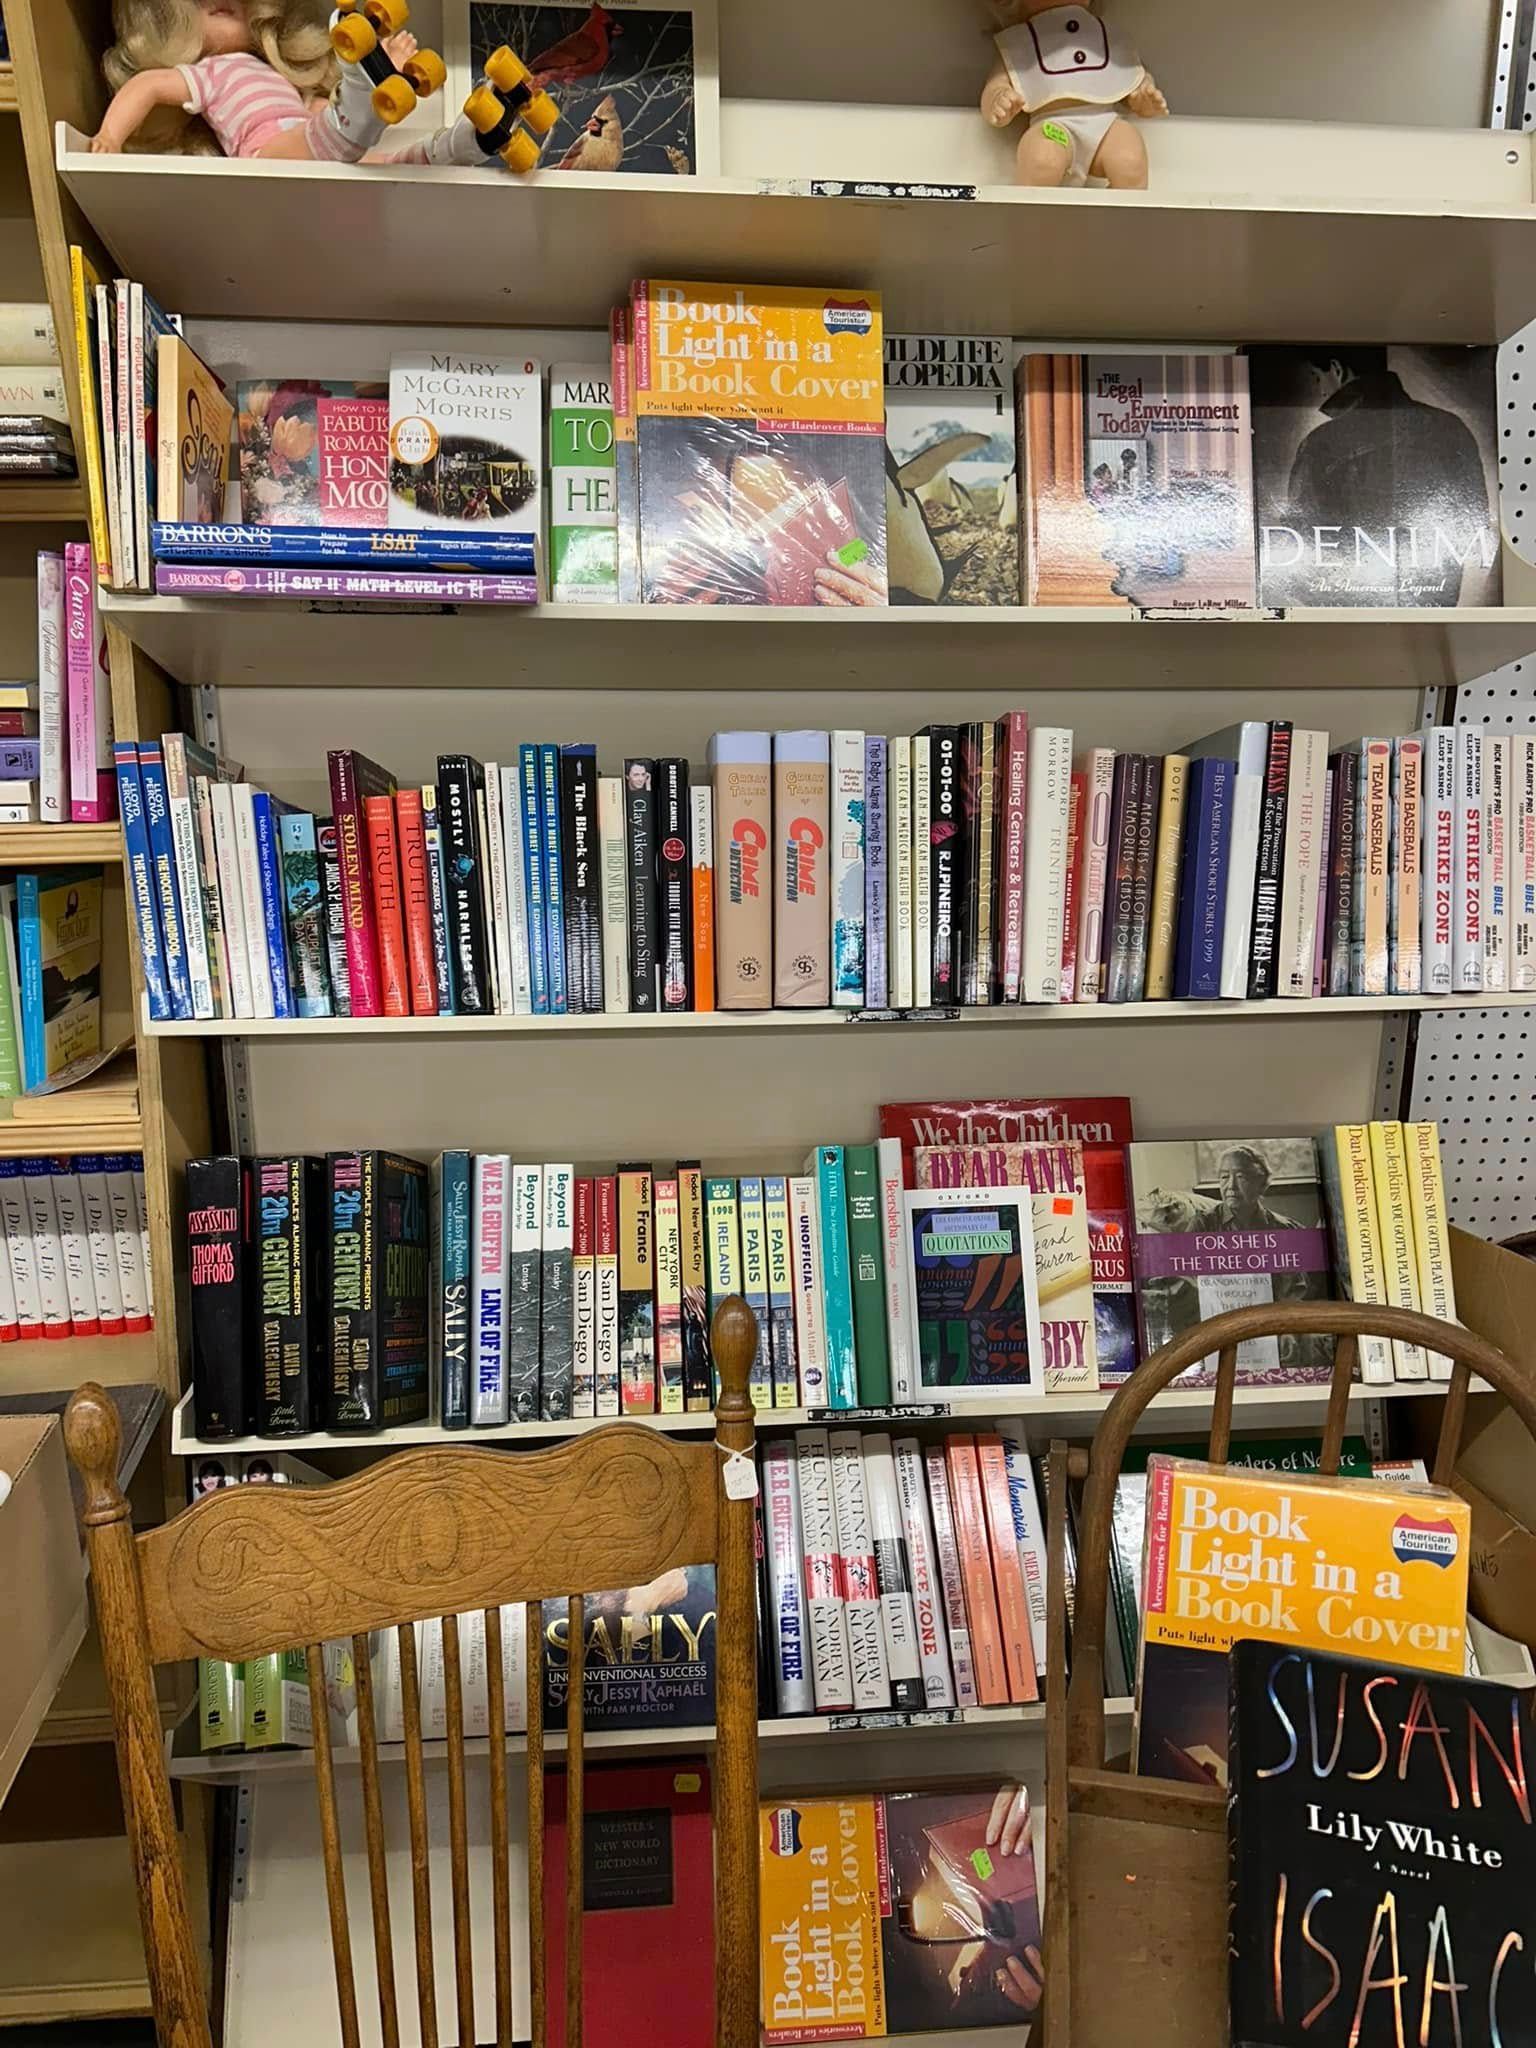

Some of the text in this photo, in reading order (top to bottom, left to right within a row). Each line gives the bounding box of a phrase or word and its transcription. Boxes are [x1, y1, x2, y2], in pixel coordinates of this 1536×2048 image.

[655, 287, 761, 324] Book
[431, 355, 499, 376] MARY
[657, 323, 834, 368] Light in a
[884, 339, 1004, 364] ILDLIFE
[403, 375, 525, 399] McGARRY
[660, 361, 878, 400] Book Cover
[1096, 378, 1143, 403] Legal
[416, 398, 513, 421] MORRIS
[771, 420, 877, 433] For Hardcover Books
[1098, 412, 1150, 438] Today
[1131, 399, 1239, 420] Environment
[161, 525, 272, 545] BARRON'S
[371, 532, 418, 551] LSAT
[1260, 526, 1494, 568] DENIM
[69, 575, 89, 640] Curves
[169, 573, 223, 585] BARRON'S
[292, 576, 340, 591] SAT II
[940, 740, 952, 815] 01-01-00
[1047, 736, 1057, 801] MORROW
[1170, 766, 1182, 803] DOVE
[1445, 758, 1453, 796] BOUTON
[121, 777, 134, 826] PERCIVAL
[146, 777, 159, 827] PERCIVAL
[449, 784, 464, 846] MOSTLY
[1402, 761, 1415, 874] TEAM BASEBALLS
[574, 783, 588, 888] The Black Sea
[629, 799, 646, 866] Clay Aiken
[732, 819, 767, 898] CRIME
[789, 817, 824, 896] CRIME
[1007, 751, 1025, 954] Healing Centers & Retreats
[375, 829, 395, 910] TRUTH
[405, 823, 426, 905] TRUTH
[1436, 810, 1451, 944] STRIKE ZONE
[1466, 809, 1480, 943] STRIKE ZONE
[1045, 826, 1063, 969] TRINITY FIELDS
[930, 1146, 1084, 1195] DEAR ANN,
[189, 1208, 237, 1234] ASSASSINI
[481, 1162, 502, 1274] W.E.B. GRIFFIN
[523, 1174, 538, 1230] Beyond
[554, 1173, 569, 1229] Beyond
[1348, 1128, 1375, 1290] Dan Jenkins YOU GOTTA PLAY
[1383, 1124, 1410, 1286] Dan Jenkins YOU GOTTA PLAY
[1416, 1125, 1447, 1319] Dan Jenkins YOU GOTTA PLAY HURT
[192, 1242, 234, 1264] THOMAS
[260, 1160, 290, 1316] THE 20TH CENTURY
[334, 1158, 362, 1311] THE 20TH CENTURY
[746, 1229, 760, 1282] PARIS
[771, 1229, 786, 1282] PARIS
[926, 1235, 1009, 1252] QUOTATIONS
[1169, 1253, 1300, 1271] THE TREE OF LIFE
[1195, 1234, 1277, 1251] FOR SHE IS
[192, 1262, 235, 1285] GIFFORD
[444, 1284, 467, 1363] SALLY
[480, 1289, 501, 1393] LINE OF FIRE
[575, 1270, 591, 1364] San Diego
[597, 1269, 615, 1363] San Diego
[284, 1344, 300, 1376] DAVID
[1281, 1450, 1356, 1470] of Nare
[1384, 1472, 1411, 1481] Guide
[811, 1443, 834, 1547] HUNTING
[831, 1446, 851, 1552] DOWN AMANDA
[845, 1446, 868, 1551] HUNTING
[1177, 1485, 1310, 1543] Book
[1151, 1475, 1170, 1611] Accessories for Readers
[1175, 1530, 1404, 1600] Light in a
[546, 1611, 717, 1667] SALLY
[826, 1605, 844, 1681] ANDREW
[919, 1600, 938, 1657] ZONE
[1157, 1626, 1185, 1639] Puts
[1188, 1628, 1217, 1646] light
[1174, 1577, 1460, 1652] Book Cover
[862, 1608, 882, 1684] ANDREW
[594, 1680, 707, 1704] JESSY RAPHAËL
[607, 1702, 675, 1714] PAM PROCTOR
[1256, 1654, 1533, 1825] SUSAN
[1307, 1803, 1503, 1868] Lily White
[1373, 1861, 1431, 1881] A Novel
[803, 1844, 842, 2019] Light in a
[832, 1803, 866, 2017] Book Cover
[771, 1918, 802, 2021] Book
